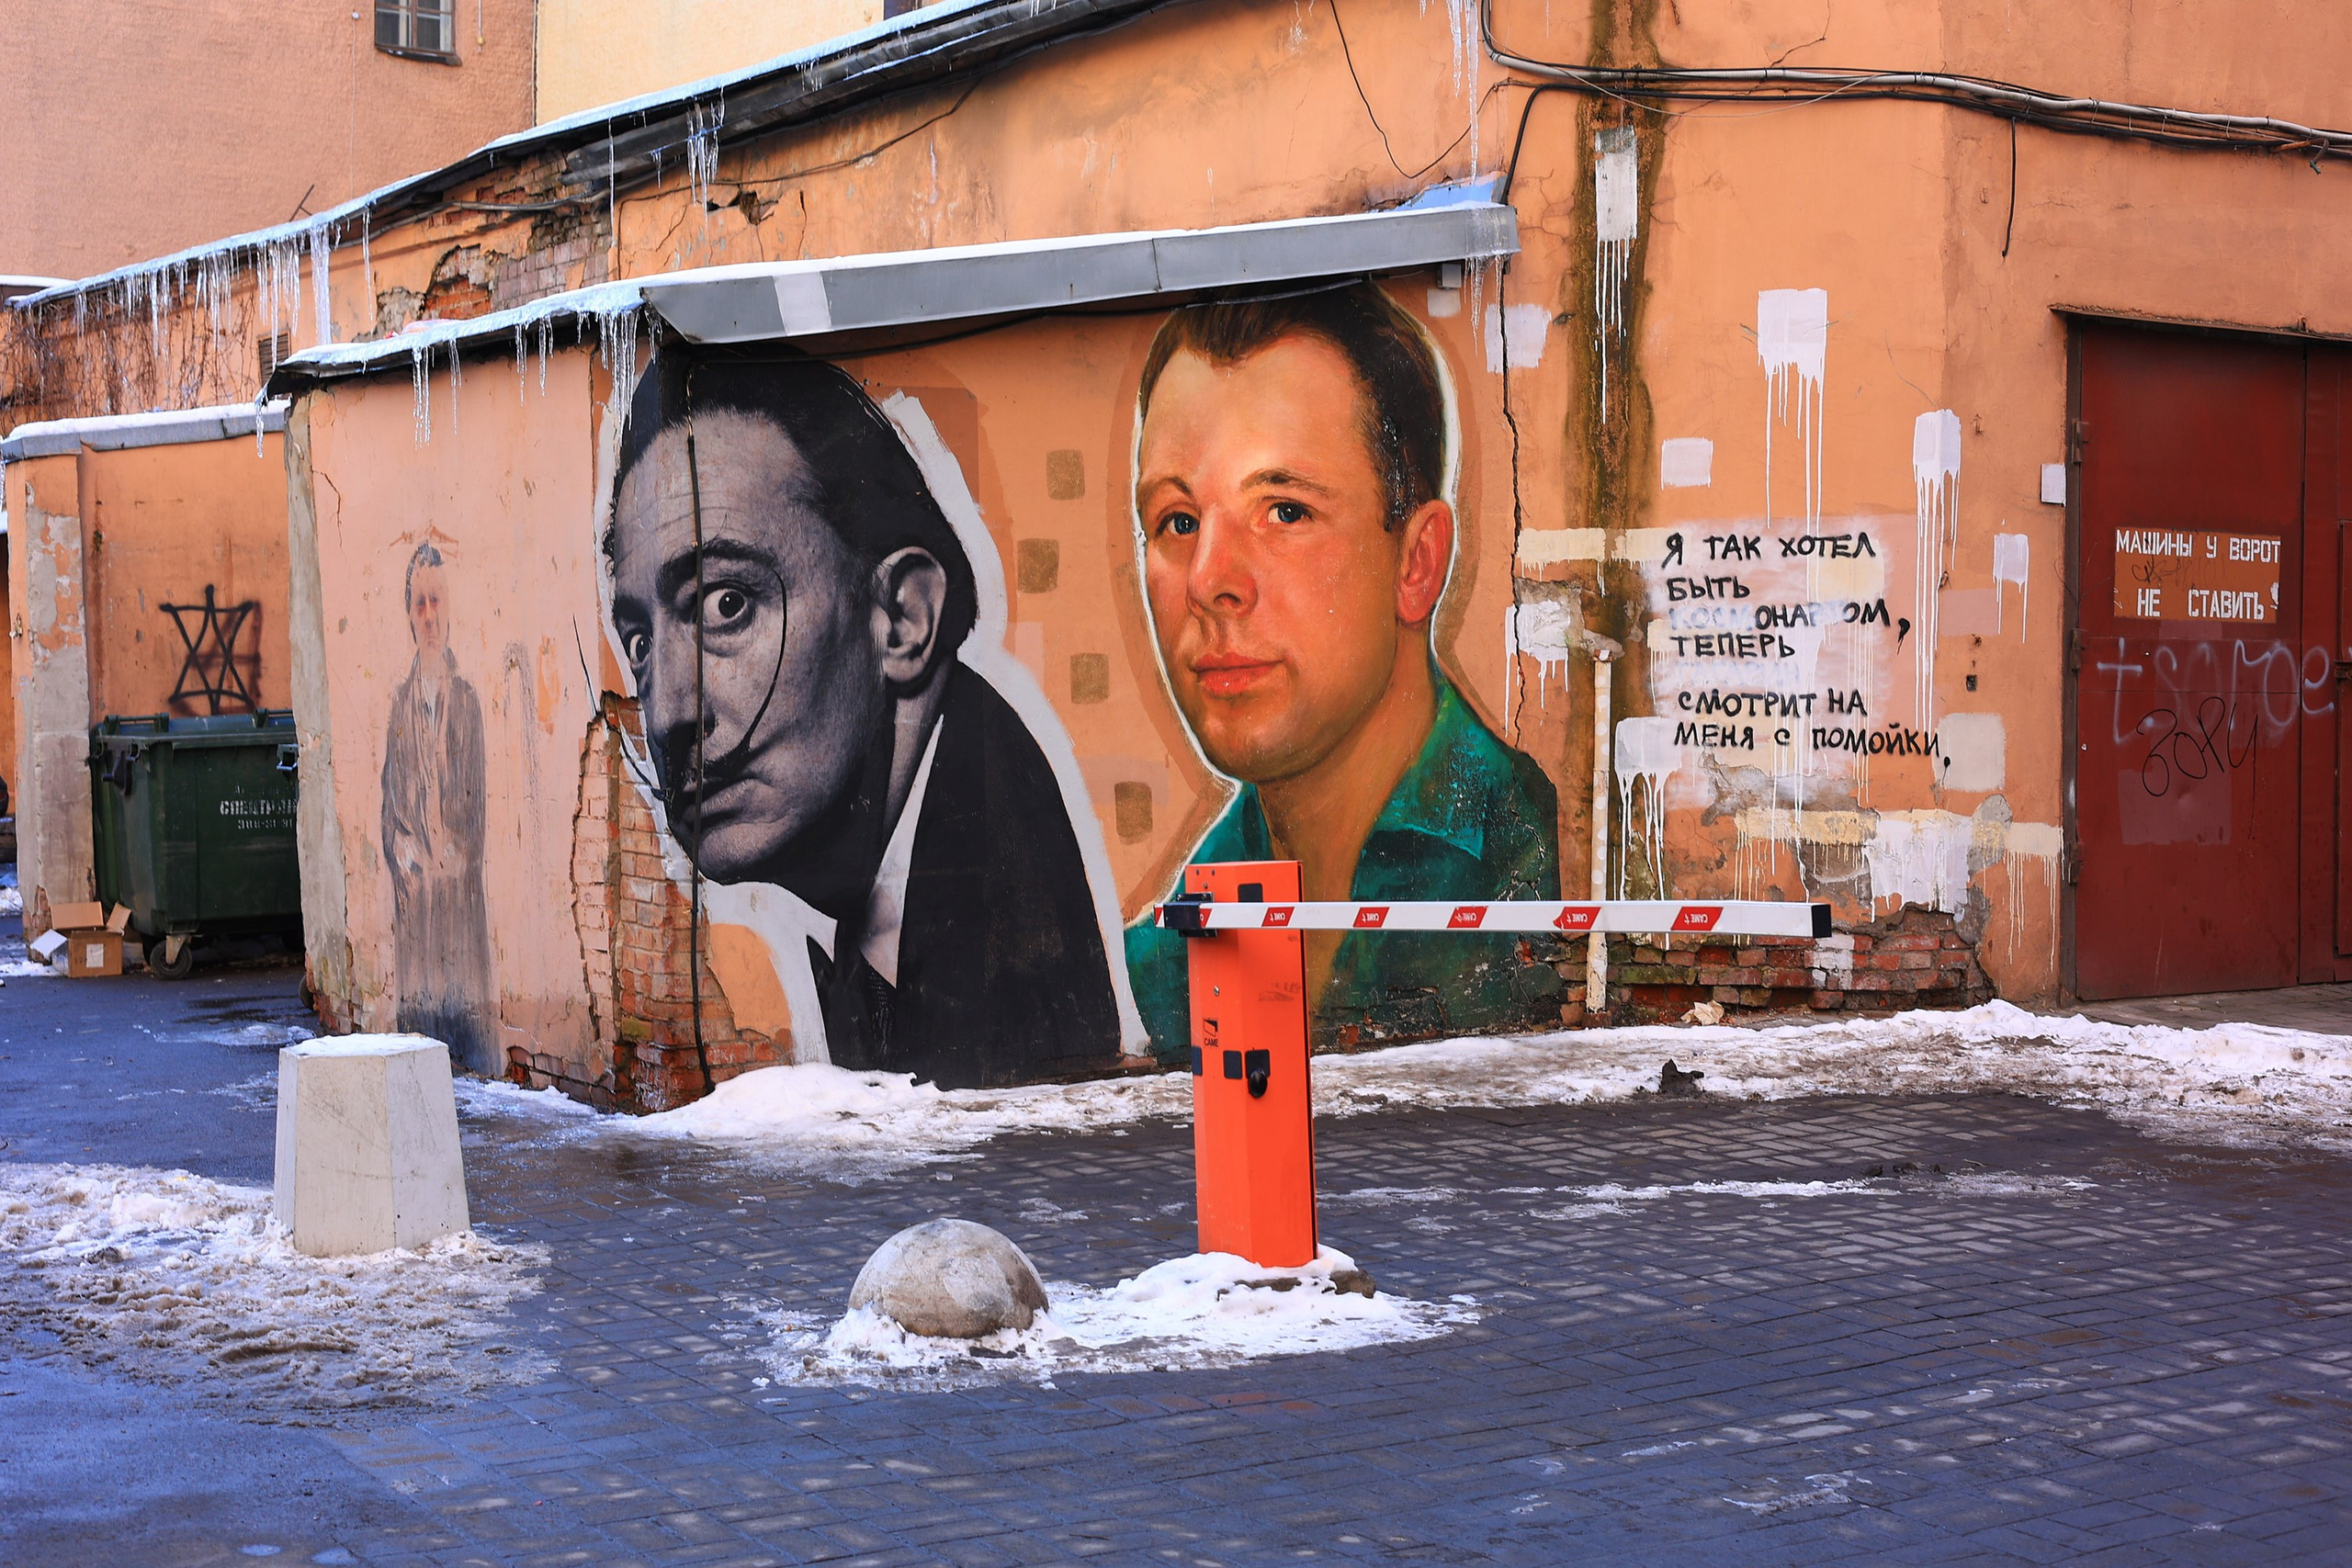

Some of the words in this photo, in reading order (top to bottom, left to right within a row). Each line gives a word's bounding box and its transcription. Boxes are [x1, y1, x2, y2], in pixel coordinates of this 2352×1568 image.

[1661, 532, 1684, 569] Я
[1703, 534, 1761, 560] ТАК
[1779, 532, 1876, 558] ХОТЕЛ
[2116, 529, 2193, 558] МАШИНЫ
[2206, 536, 2218, 558] У
[2229, 537, 2281, 563] ВОРОТ
[1667, 576, 1751, 601] БЫТЬ
[2137, 588, 2162, 617] НЕ
[2188, 589, 2265, 620] СТАВИТЬ
[1670, 633, 1795, 658] ТЕПЕРЬ
[1679, 689, 1817, 717] СМОТРИТ
[1828, 688, 1868, 716] НА
[1674, 722, 1754, 750] МЕНЯ
[1204, 1037, 1219, 1047] CAME
